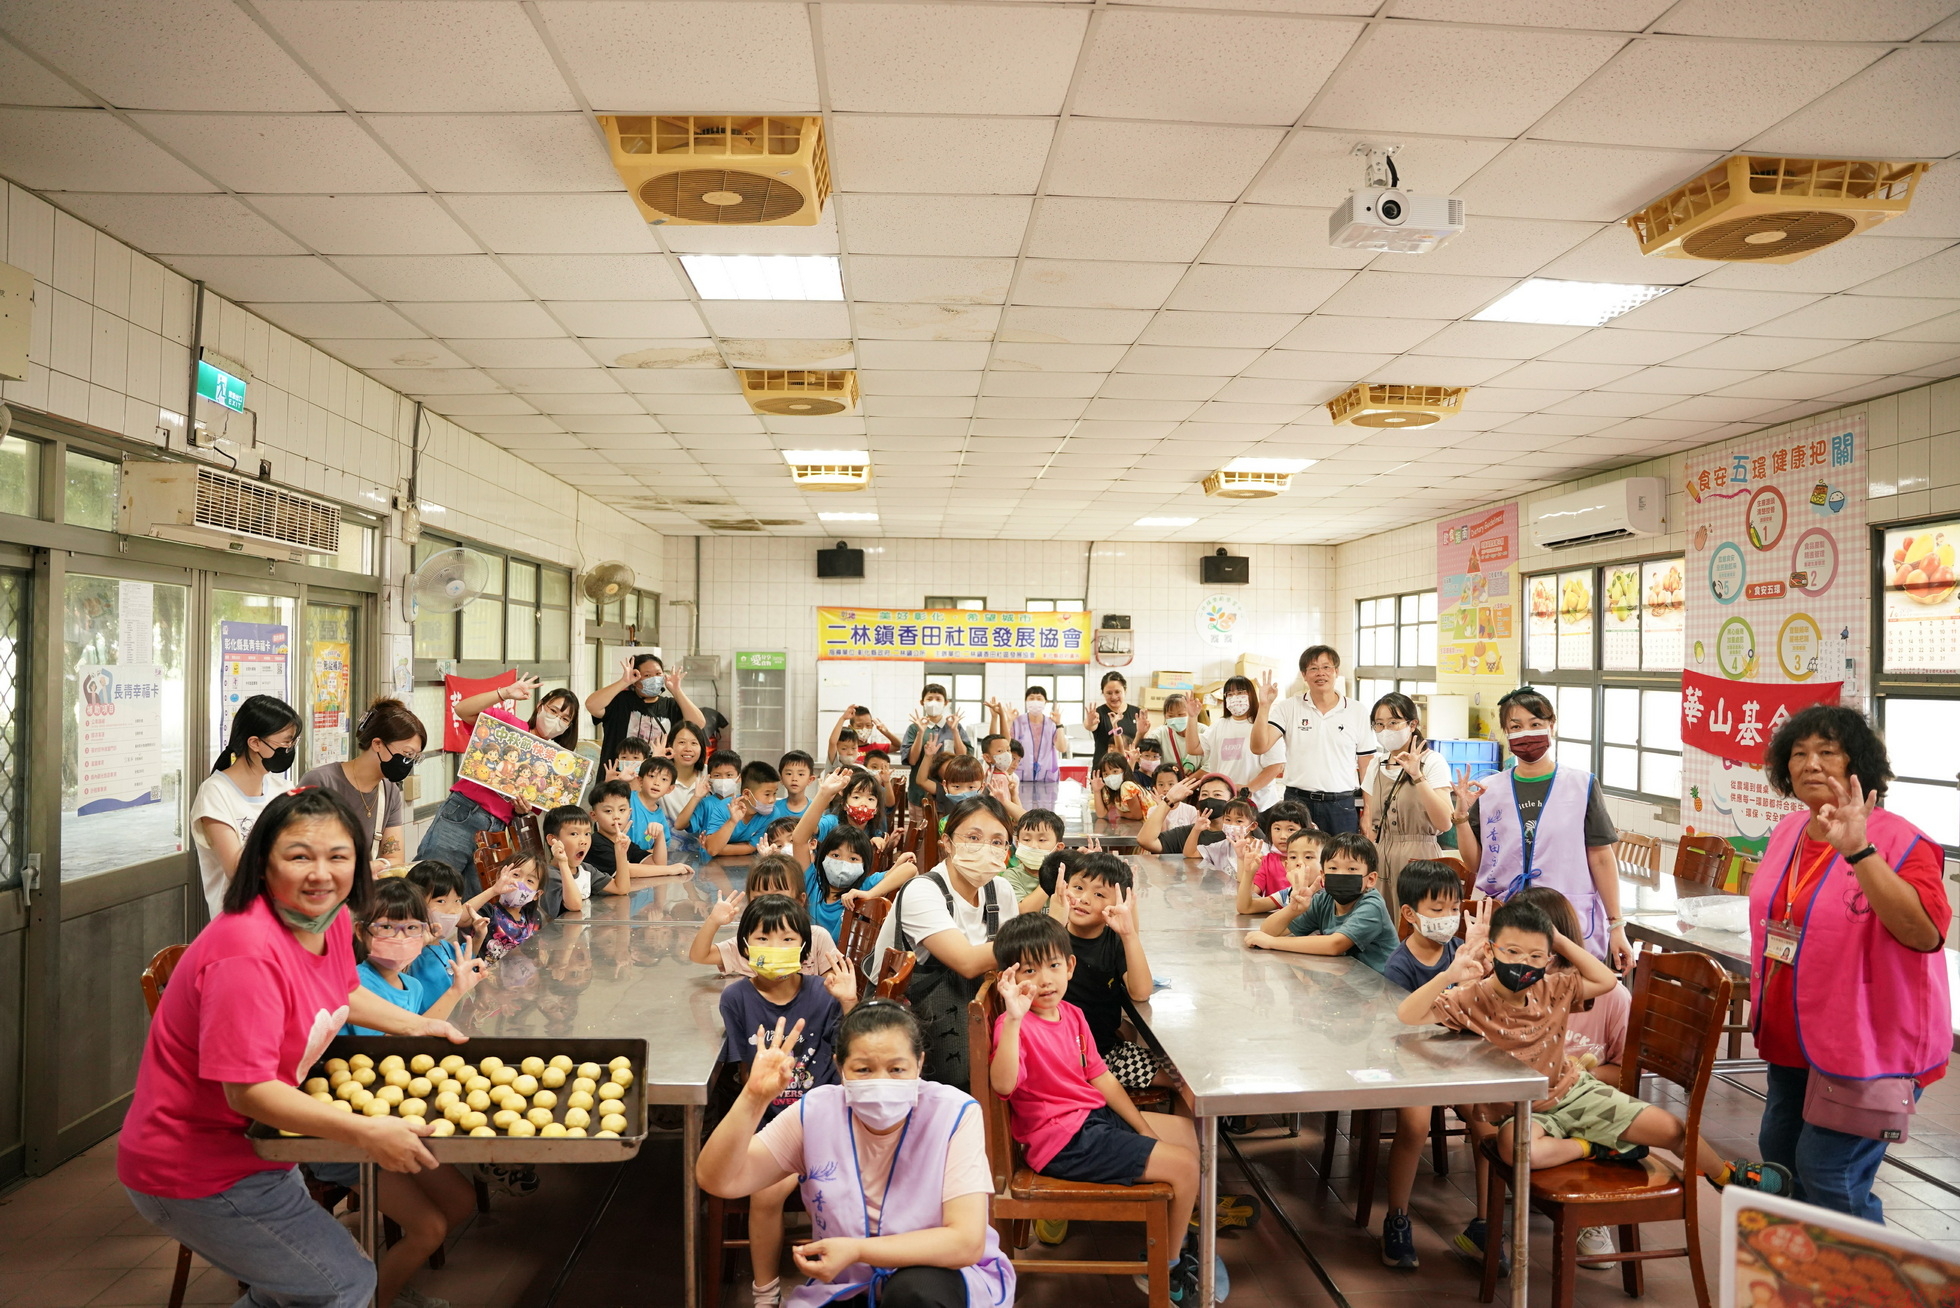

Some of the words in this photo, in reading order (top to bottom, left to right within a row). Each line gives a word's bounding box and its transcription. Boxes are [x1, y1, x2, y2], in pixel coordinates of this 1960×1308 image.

[228, 399, 241, 408] EXIT
[1698, 455, 1767, 492] 食安五環
[1771, 432, 1854, 474] 健康把關
[1762, 525, 1768, 541] 1
[1810, 570, 1817, 587] 2
[1724, 581, 1729, 595] 5
[1753, 584, 1781, 596] 食安五環
[827, 624, 1083, 648] 二林鎮香田社區發展協會
[1731, 657, 1738, 671] 4
[1794, 654, 1801, 671] 3
[114, 683, 159, 699] 長青幸福卡
[495, 726, 557, 762] 中秋節快樂
[1518, 800, 1535, 810] ittle
[1565, 1029, 1591, 1045] UCK
